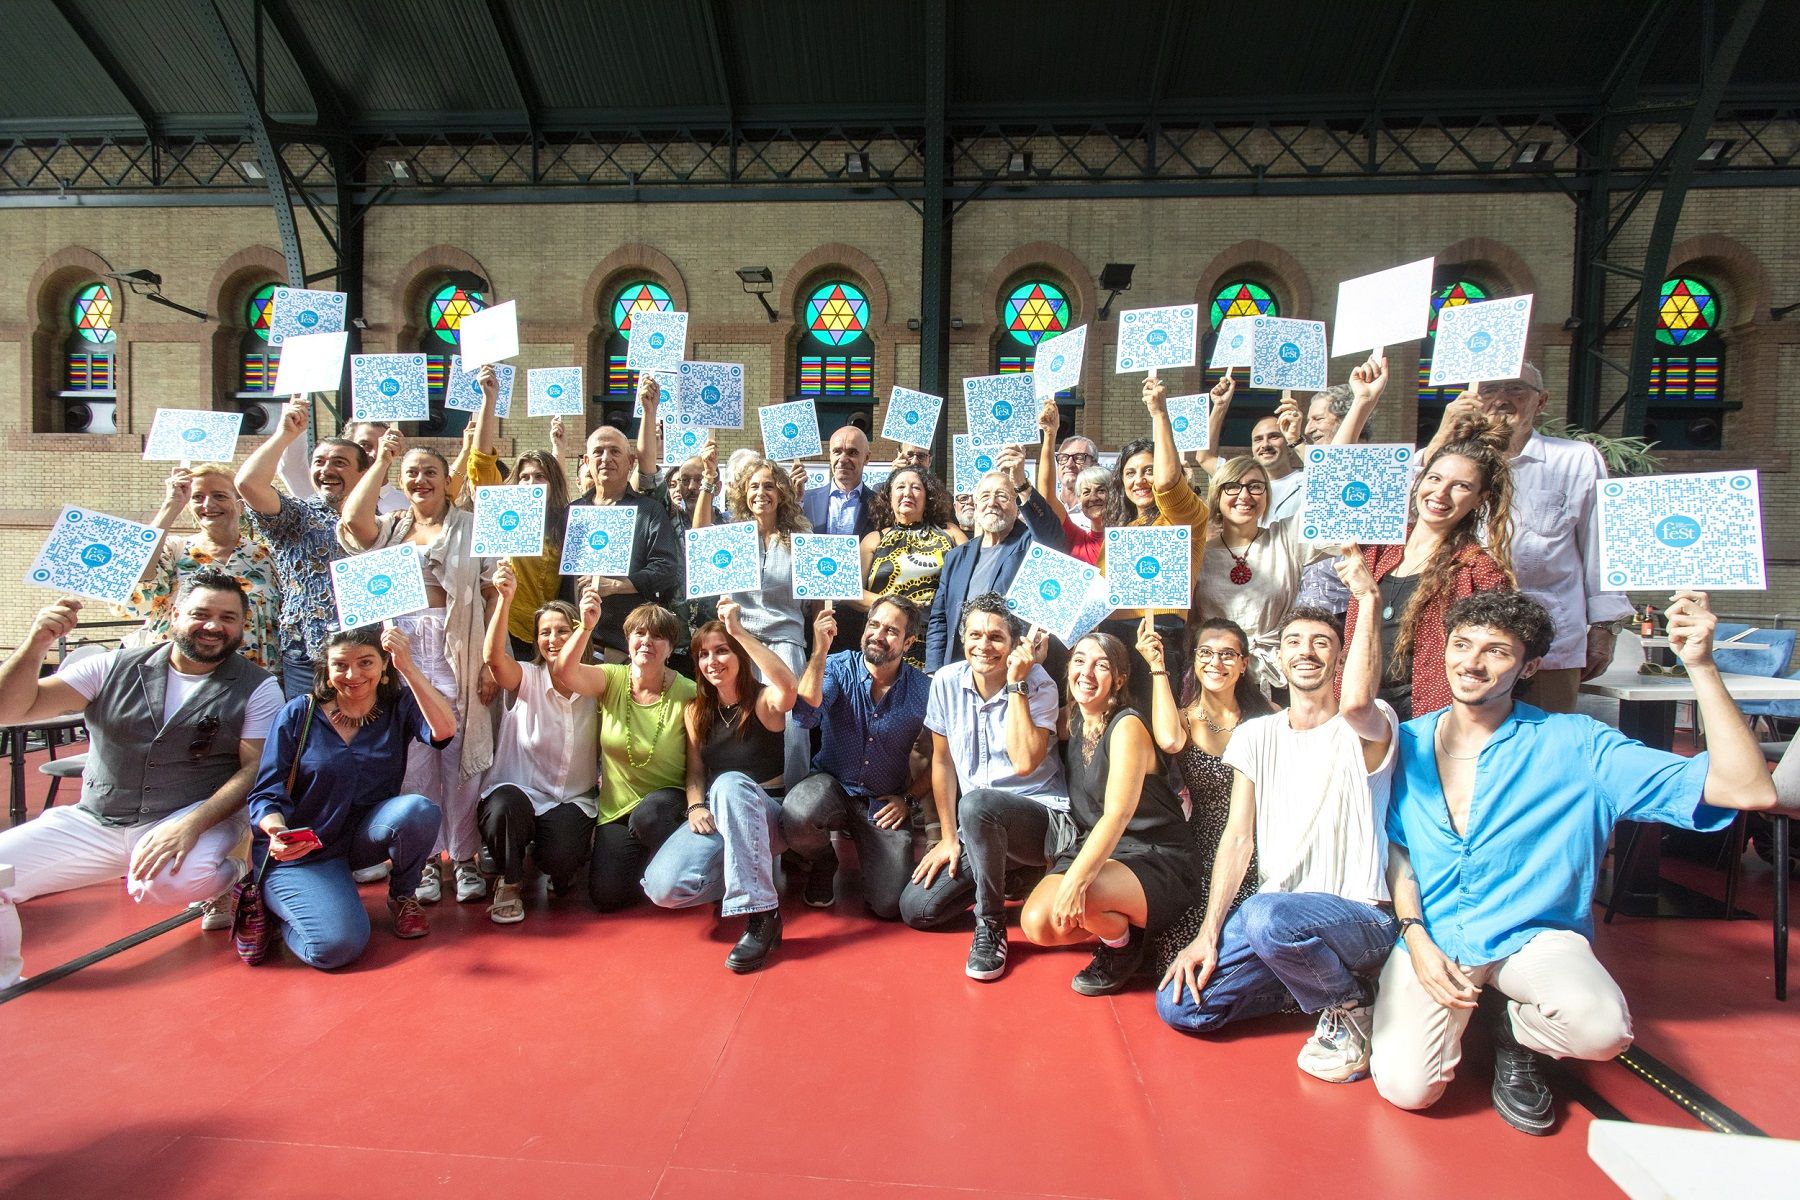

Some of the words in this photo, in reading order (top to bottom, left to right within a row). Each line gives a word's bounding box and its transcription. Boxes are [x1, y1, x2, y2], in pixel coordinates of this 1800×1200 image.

[1282, 346, 1298, 358] fest
[383, 382, 396, 392] fest
[996, 404, 1009, 416] fest
[1344, 486, 1366, 502] fest
[1661, 522, 1696, 540] fest
[84, 547, 105, 563] fest
[715, 554, 729, 564] fest
[820, 561, 834, 572] fest
[1139, 561, 1157, 574] fest
